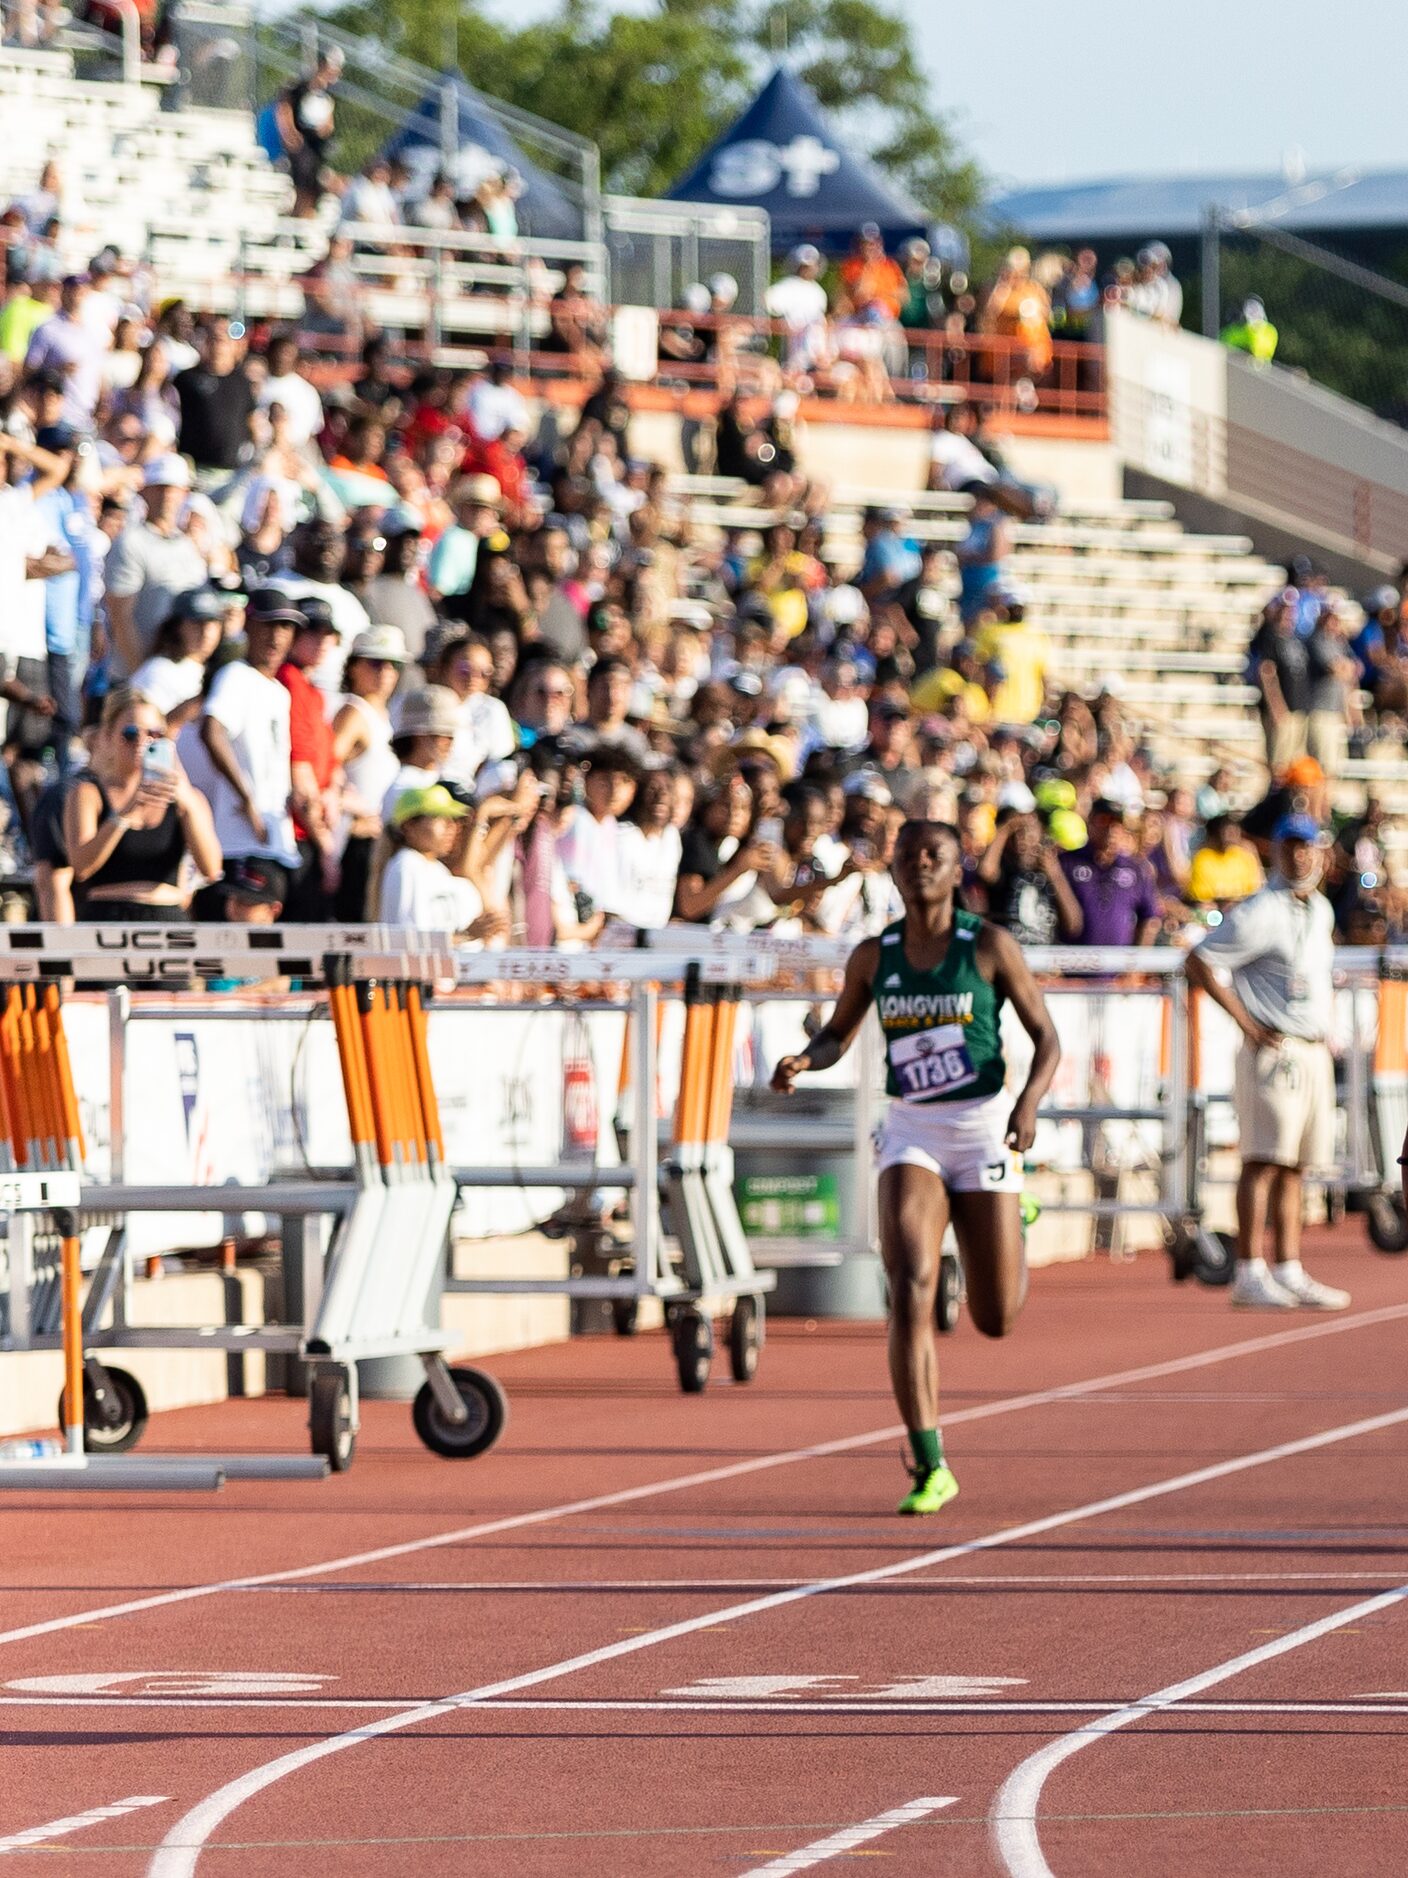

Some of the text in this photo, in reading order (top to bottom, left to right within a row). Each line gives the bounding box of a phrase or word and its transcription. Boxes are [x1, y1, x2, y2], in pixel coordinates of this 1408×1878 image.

[96, 931, 197, 950] UCS
[123, 958, 224, 980] UCS
[879, 991, 974, 1018] LONGVIEW
[903, 1048, 967, 1091] 1736
